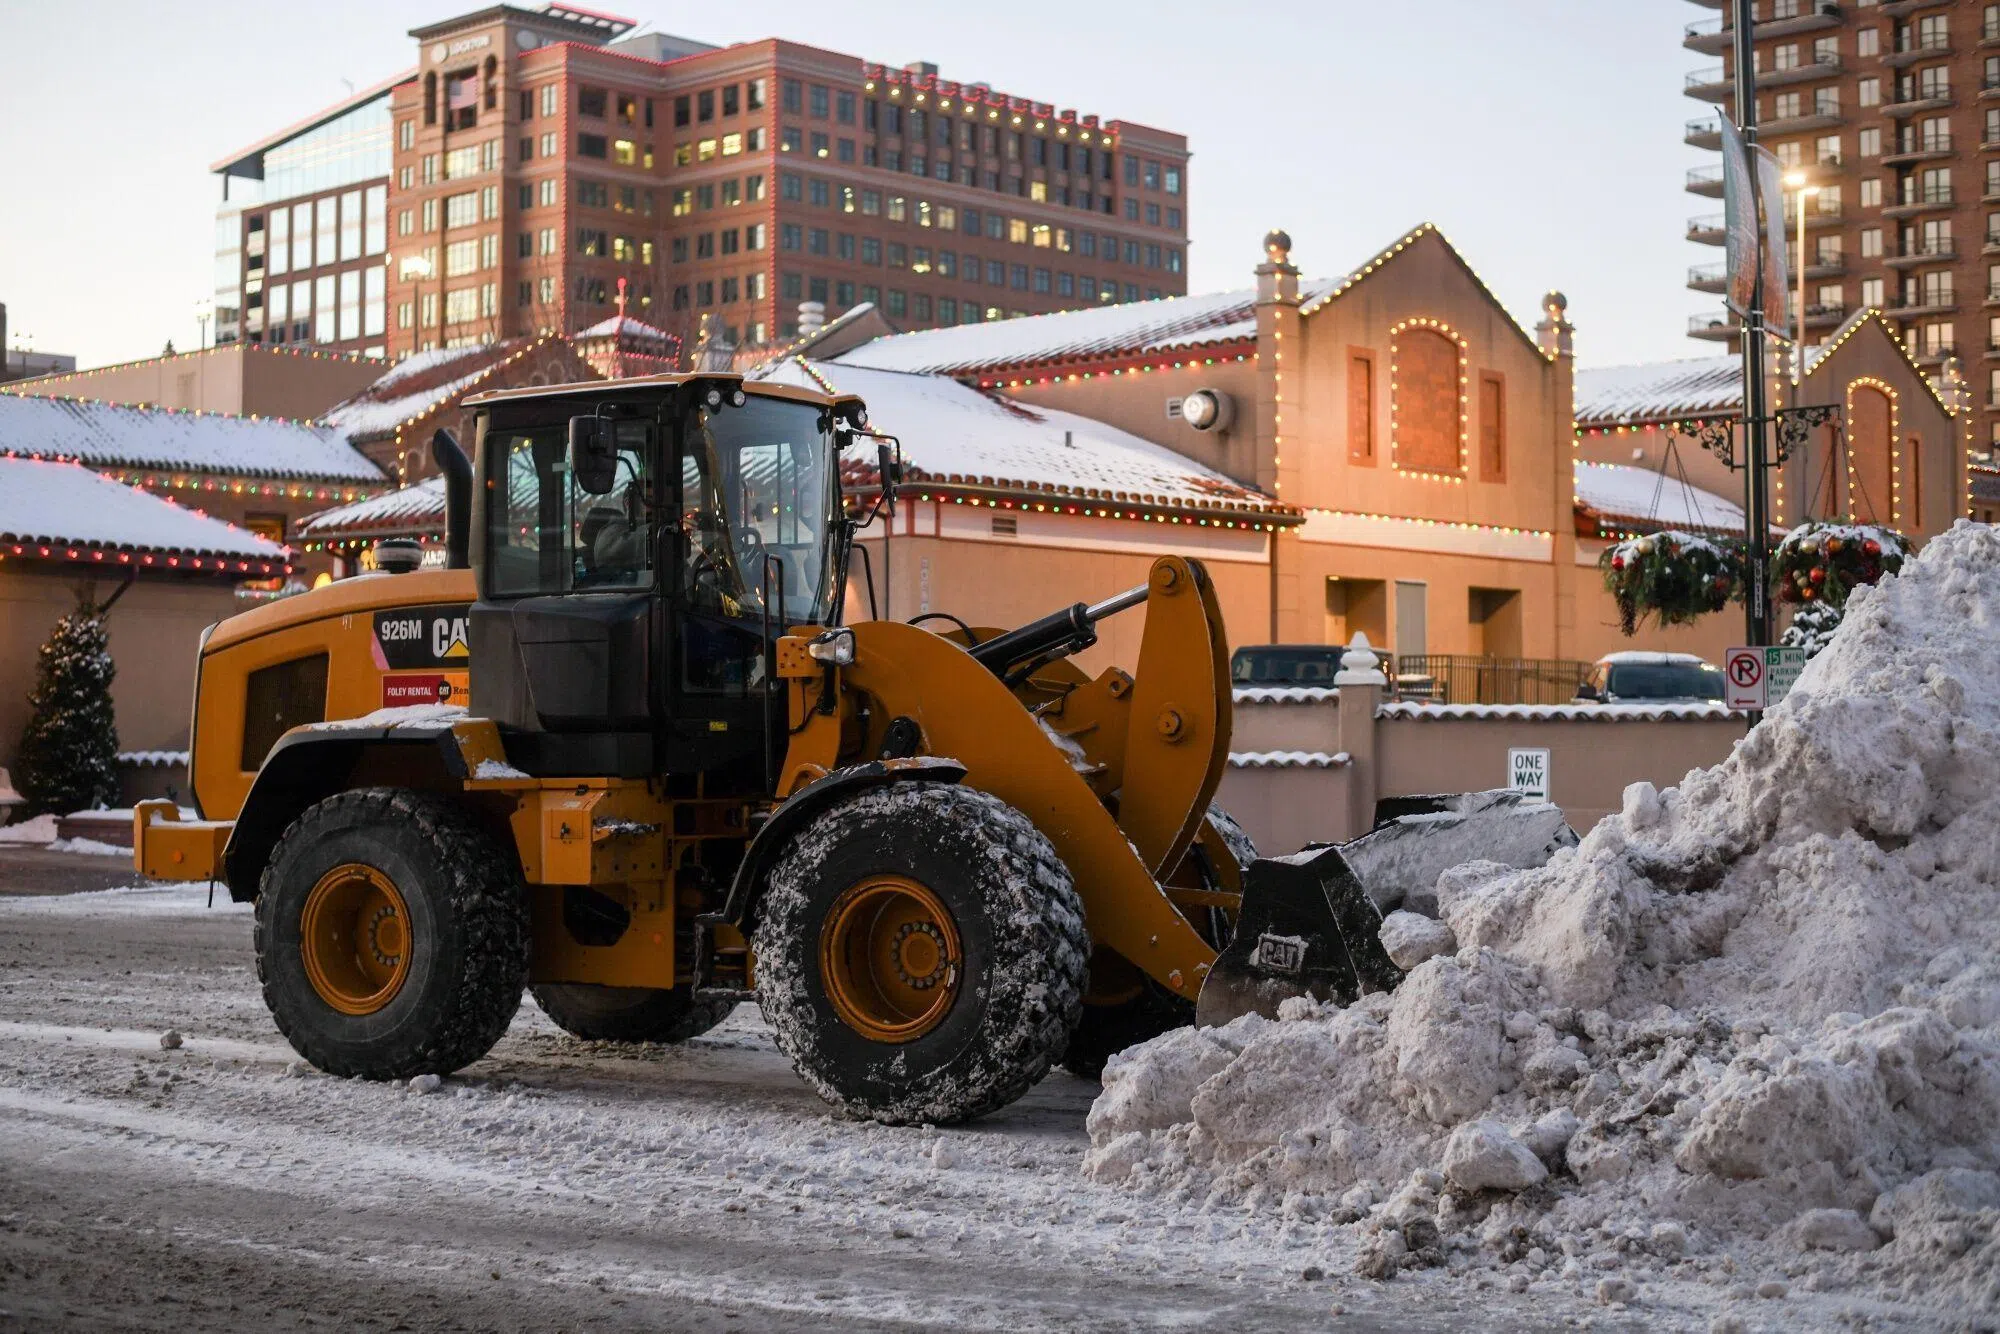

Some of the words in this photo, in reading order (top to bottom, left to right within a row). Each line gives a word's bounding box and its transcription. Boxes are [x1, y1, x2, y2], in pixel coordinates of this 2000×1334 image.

[381, 619, 422, 641] 926M
[432, 617, 470, 658] CA
[1769, 652, 1780, 664] 15
[1784, 652, 1802, 663] MIN
[387, 686, 407, 697] FOLEY
[407, 686, 432, 697] RENTAL
[438, 685, 450, 696] CAT
[453, 686, 470, 696] Ren
[1515, 754, 1543, 770] ONE
[1514, 771, 1543, 787] WAY
[1260, 940, 1299, 969] CAT
